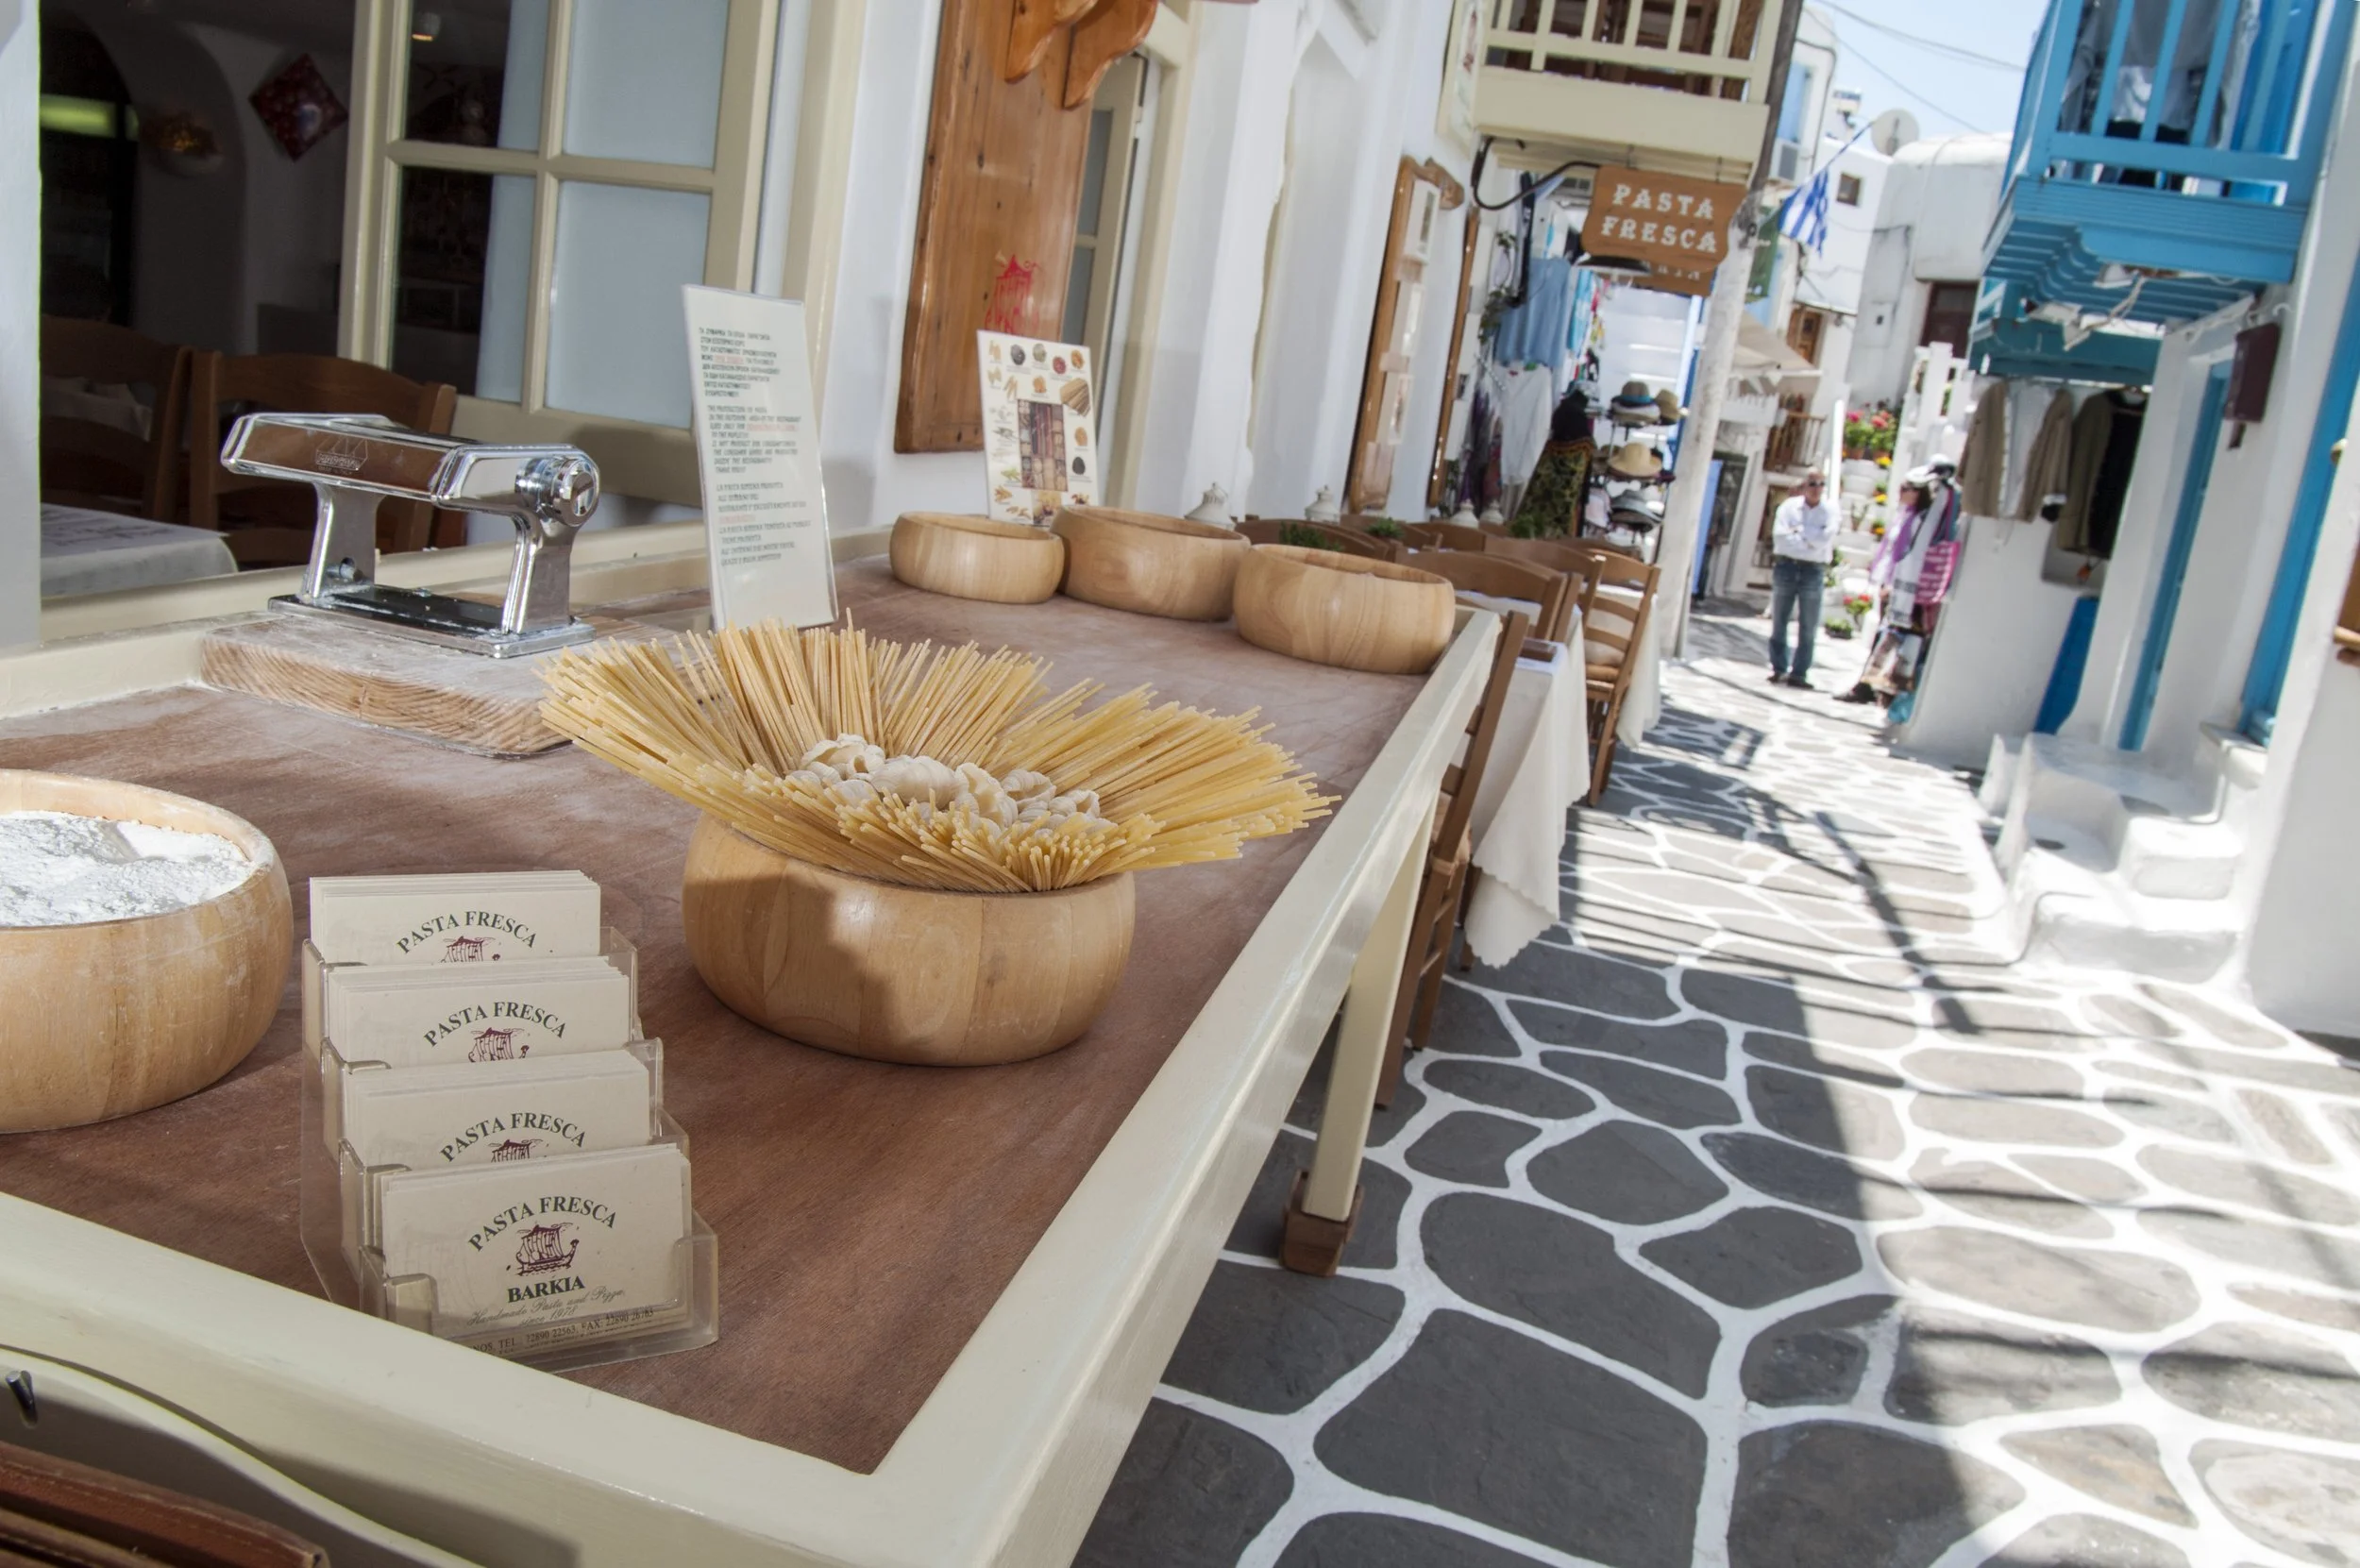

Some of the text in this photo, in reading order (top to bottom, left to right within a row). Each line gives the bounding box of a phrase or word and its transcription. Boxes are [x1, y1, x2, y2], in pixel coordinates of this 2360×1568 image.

[1612, 184, 1713, 219] PASTA
[1601, 215, 1716, 253] FRESCA
[396, 910, 538, 954] PASTA FRESCA
[423, 1002, 568, 1047] PASTA FRESCA
[440, 1112, 587, 1162] PASTA FRESCA
[468, 1196, 616, 1252] PASTA FRESCA
[508, 1276, 584, 1304] BARKIA
[467, 1307, 528, 1326] Handmade
[531, 1297, 564, 1314] Pasta
[566, 1293, 586, 1307] and
[519, 1306, 579, 1327] since 1978
